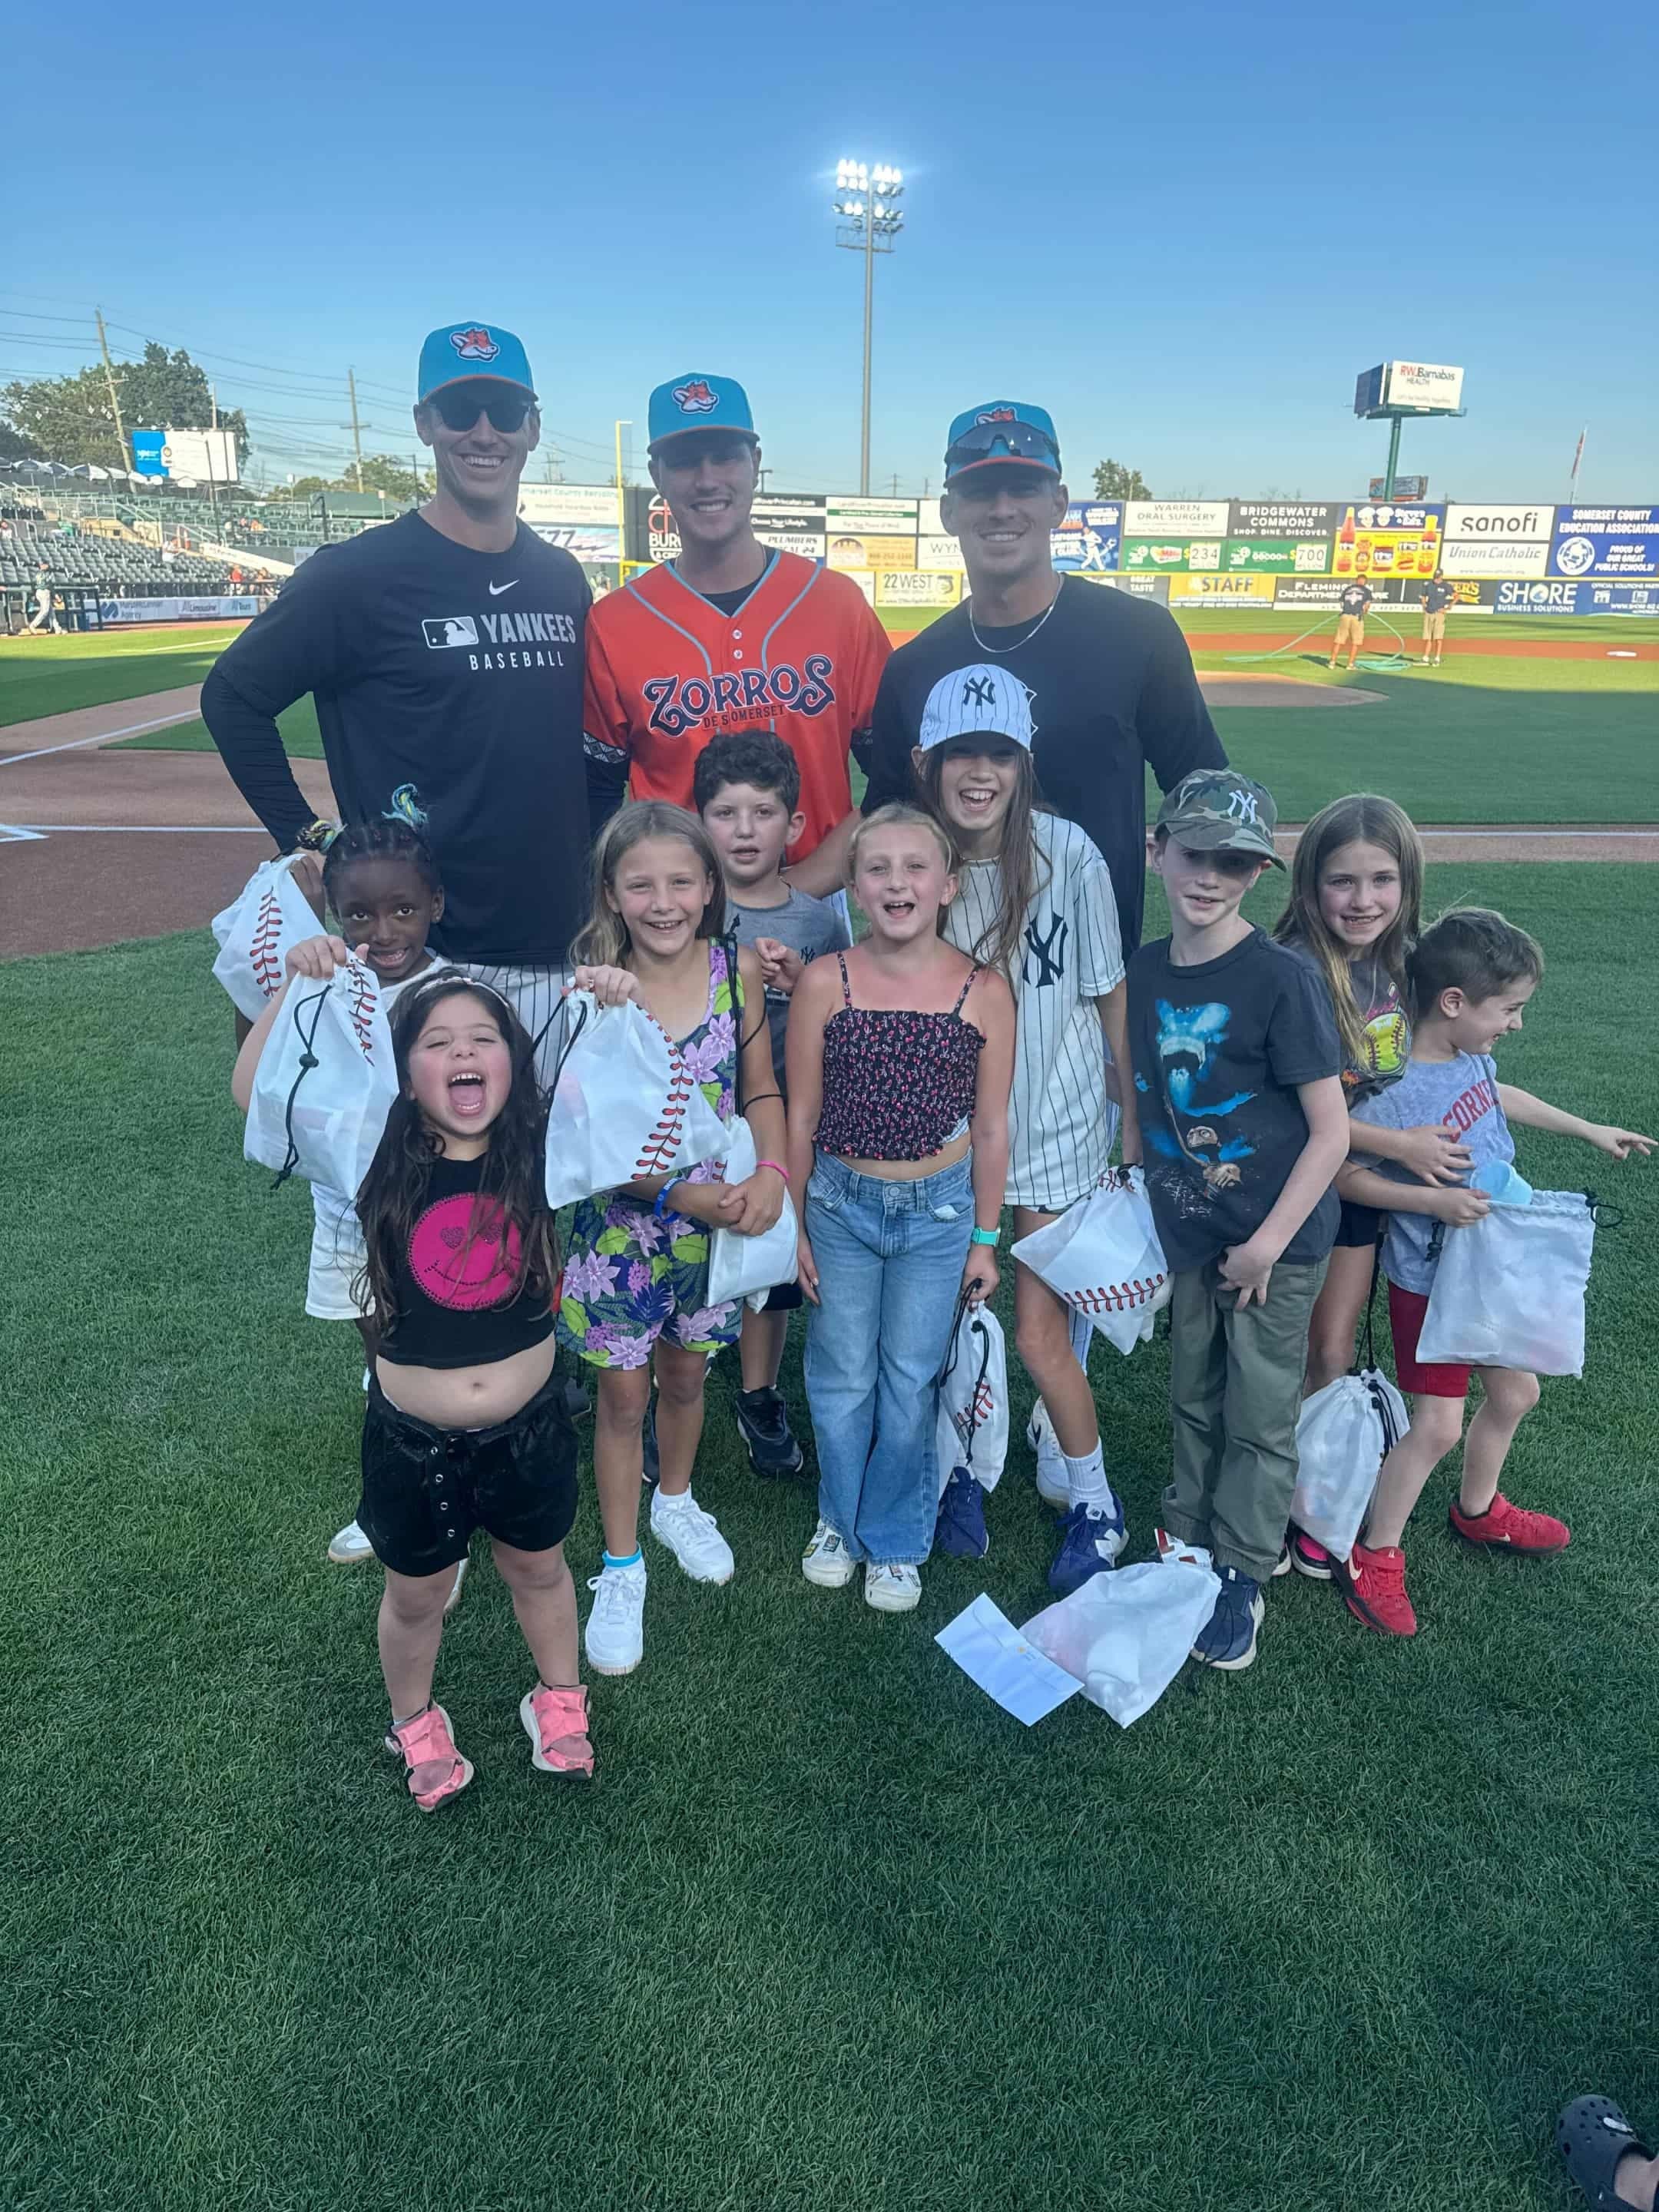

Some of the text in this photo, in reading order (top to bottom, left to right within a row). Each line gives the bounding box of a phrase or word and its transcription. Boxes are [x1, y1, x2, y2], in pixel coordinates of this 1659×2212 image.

[1167, 513, 1216, 522] SURGERY
[1240, 506, 1327, 517] BRIDGEWATER
[1572, 509, 1652, 521] SOMERSET COUNTY
[1250, 517, 1315, 527] COMMONS
[1460, 512, 1538, 532] sanofi
[1558, 522, 1605, 534] EDUCATION
[1449, 546, 1541, 558] Union Catholic
[1621, 554, 1646, 562] GREAT
[884, 574, 899, 588] 22
[899, 574, 935, 589] WEST
[1497, 604, 1575, 613] BUSINESS SOLUTIONS
[480, 612, 576, 644] YANKEES
[469, 651, 565, 671] BASEBALL
[642, 654, 836, 738] ZORROS
[963, 676, 996, 707] NY
[704, 704, 785, 729] DE SOMERSET
[1227, 790, 1258, 824] NY
[1022, 911, 1068, 988] NY
